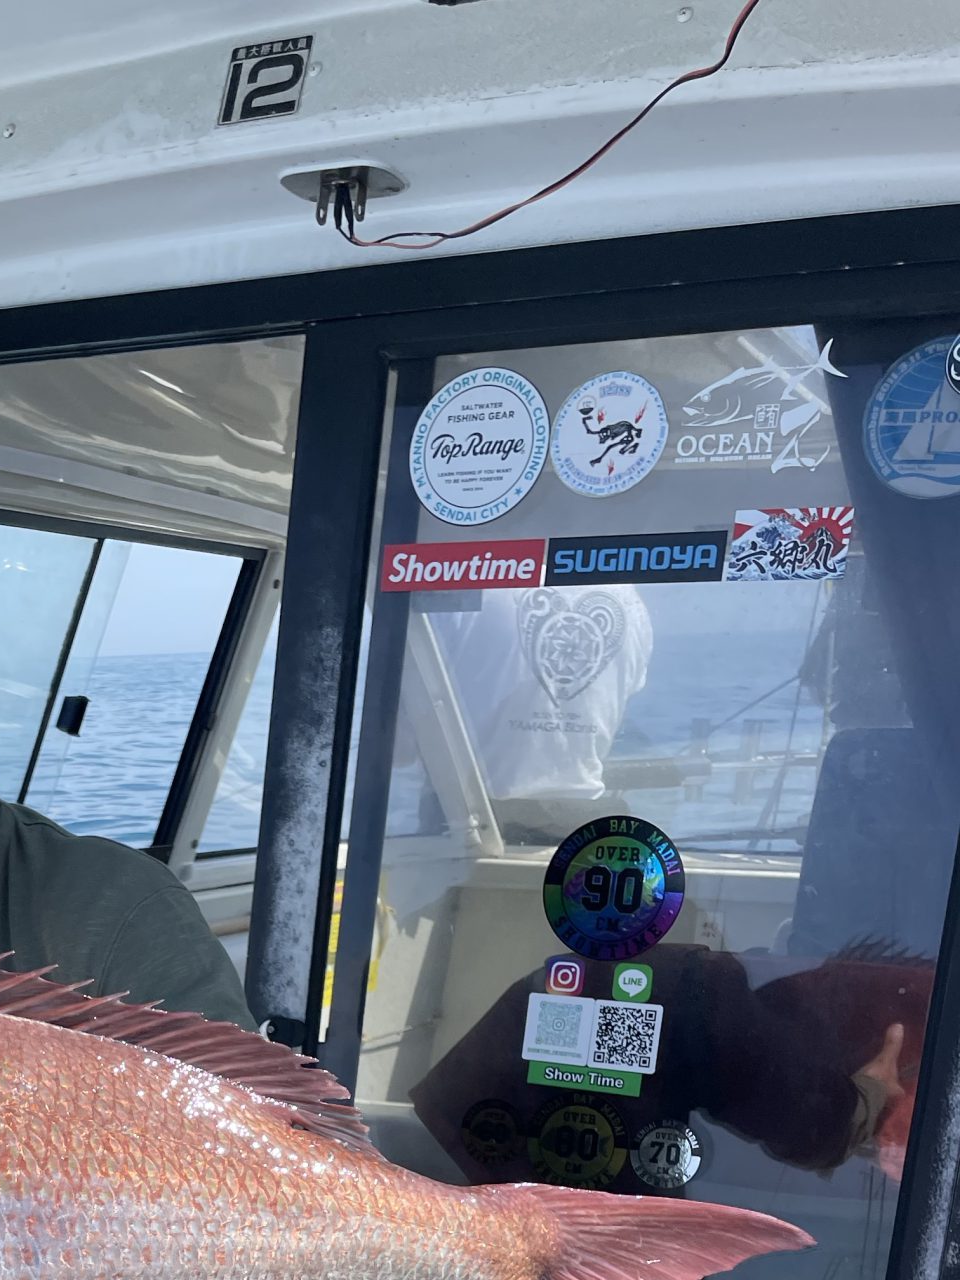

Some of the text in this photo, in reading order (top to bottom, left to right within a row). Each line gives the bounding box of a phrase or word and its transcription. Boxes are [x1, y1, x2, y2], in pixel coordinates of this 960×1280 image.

[221, 53, 305, 123] 12
[447, 410, 515, 424] FISHING GEAR
[461, 402, 504, 412] SALTWATER
[413, 424, 428, 488] M.TANNO
[426, 373, 479, 421] FACTORY
[483, 371, 537, 407] ORIGINAL
[524, 407, 546, 481] CLOTHING
[676, 432, 775, 456] OCEAN
[434, 498, 510, 522] SENDAI CITY
[388, 552, 536, 583] Showtime
[554, 544, 718, 574] SUGINOYA
[595, 846, 641, 862] OVER
[609, 819, 640, 834] BAY
[647, 831, 681, 876] MADAI
[581, 864, 645, 914] 90
[596, 917, 620, 932] CM
[623, 976, 643, 987] LINE
[544, 1067, 624, 1088] Show Time
[563, 1111, 596, 1125] OVER
[656, 1131, 679, 1141] OVER
[649, 1141, 681, 1166] 70
[565, 1162, 582, 1174] CM
